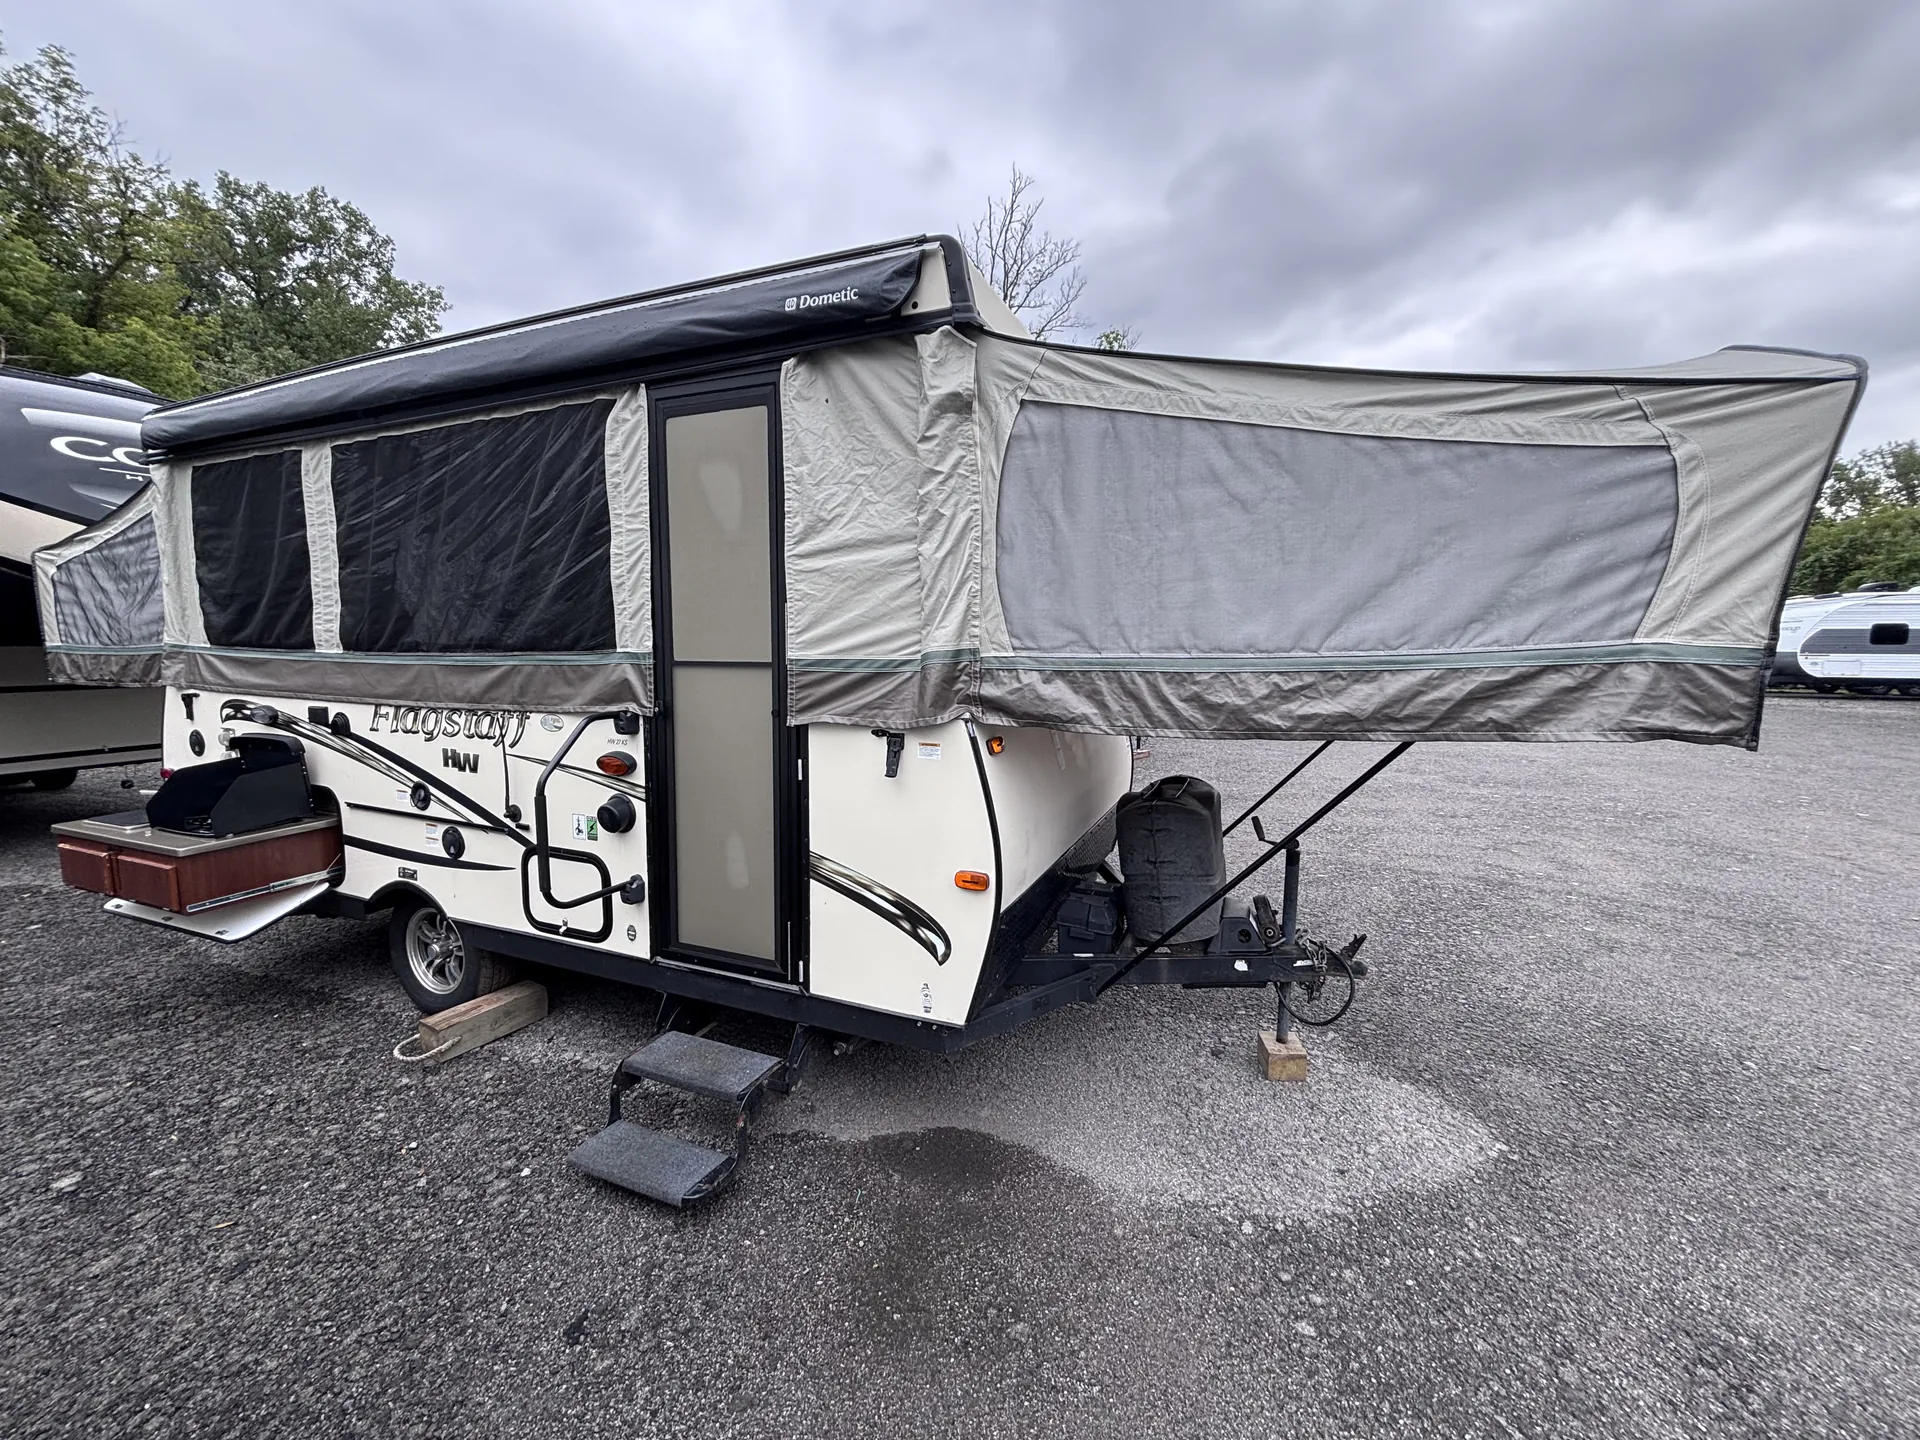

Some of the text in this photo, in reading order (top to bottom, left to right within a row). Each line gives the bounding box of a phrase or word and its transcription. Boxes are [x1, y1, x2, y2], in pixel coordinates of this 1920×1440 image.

[799, 286, 859, 309] Dometic
[369, 704, 531, 749] Flagstaff
[441, 748, 480, 774] HW
